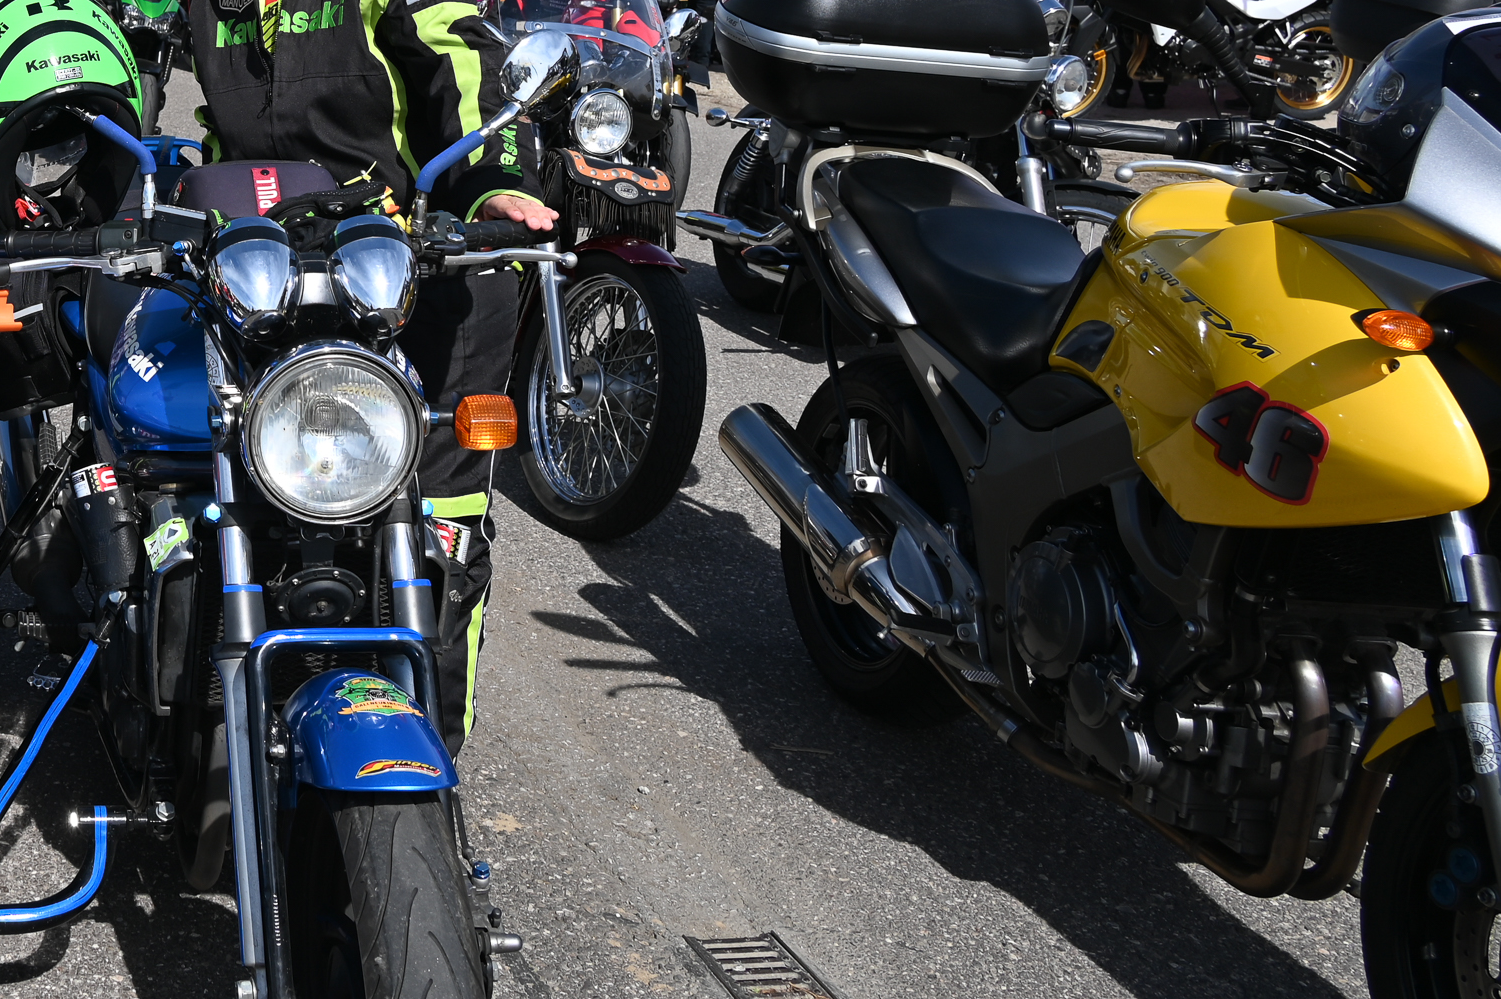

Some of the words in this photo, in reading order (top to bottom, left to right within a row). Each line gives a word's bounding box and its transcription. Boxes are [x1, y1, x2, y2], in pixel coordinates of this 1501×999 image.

[25, 50, 102, 74] Kawasaki
[92, 9, 140, 81] Kawasaki
[255, 177, 279, 209] PULL
[1154, 266, 1180, 287] 900
[1180, 289, 1275, 359] TDM
[1192, 380, 1330, 506] 46
